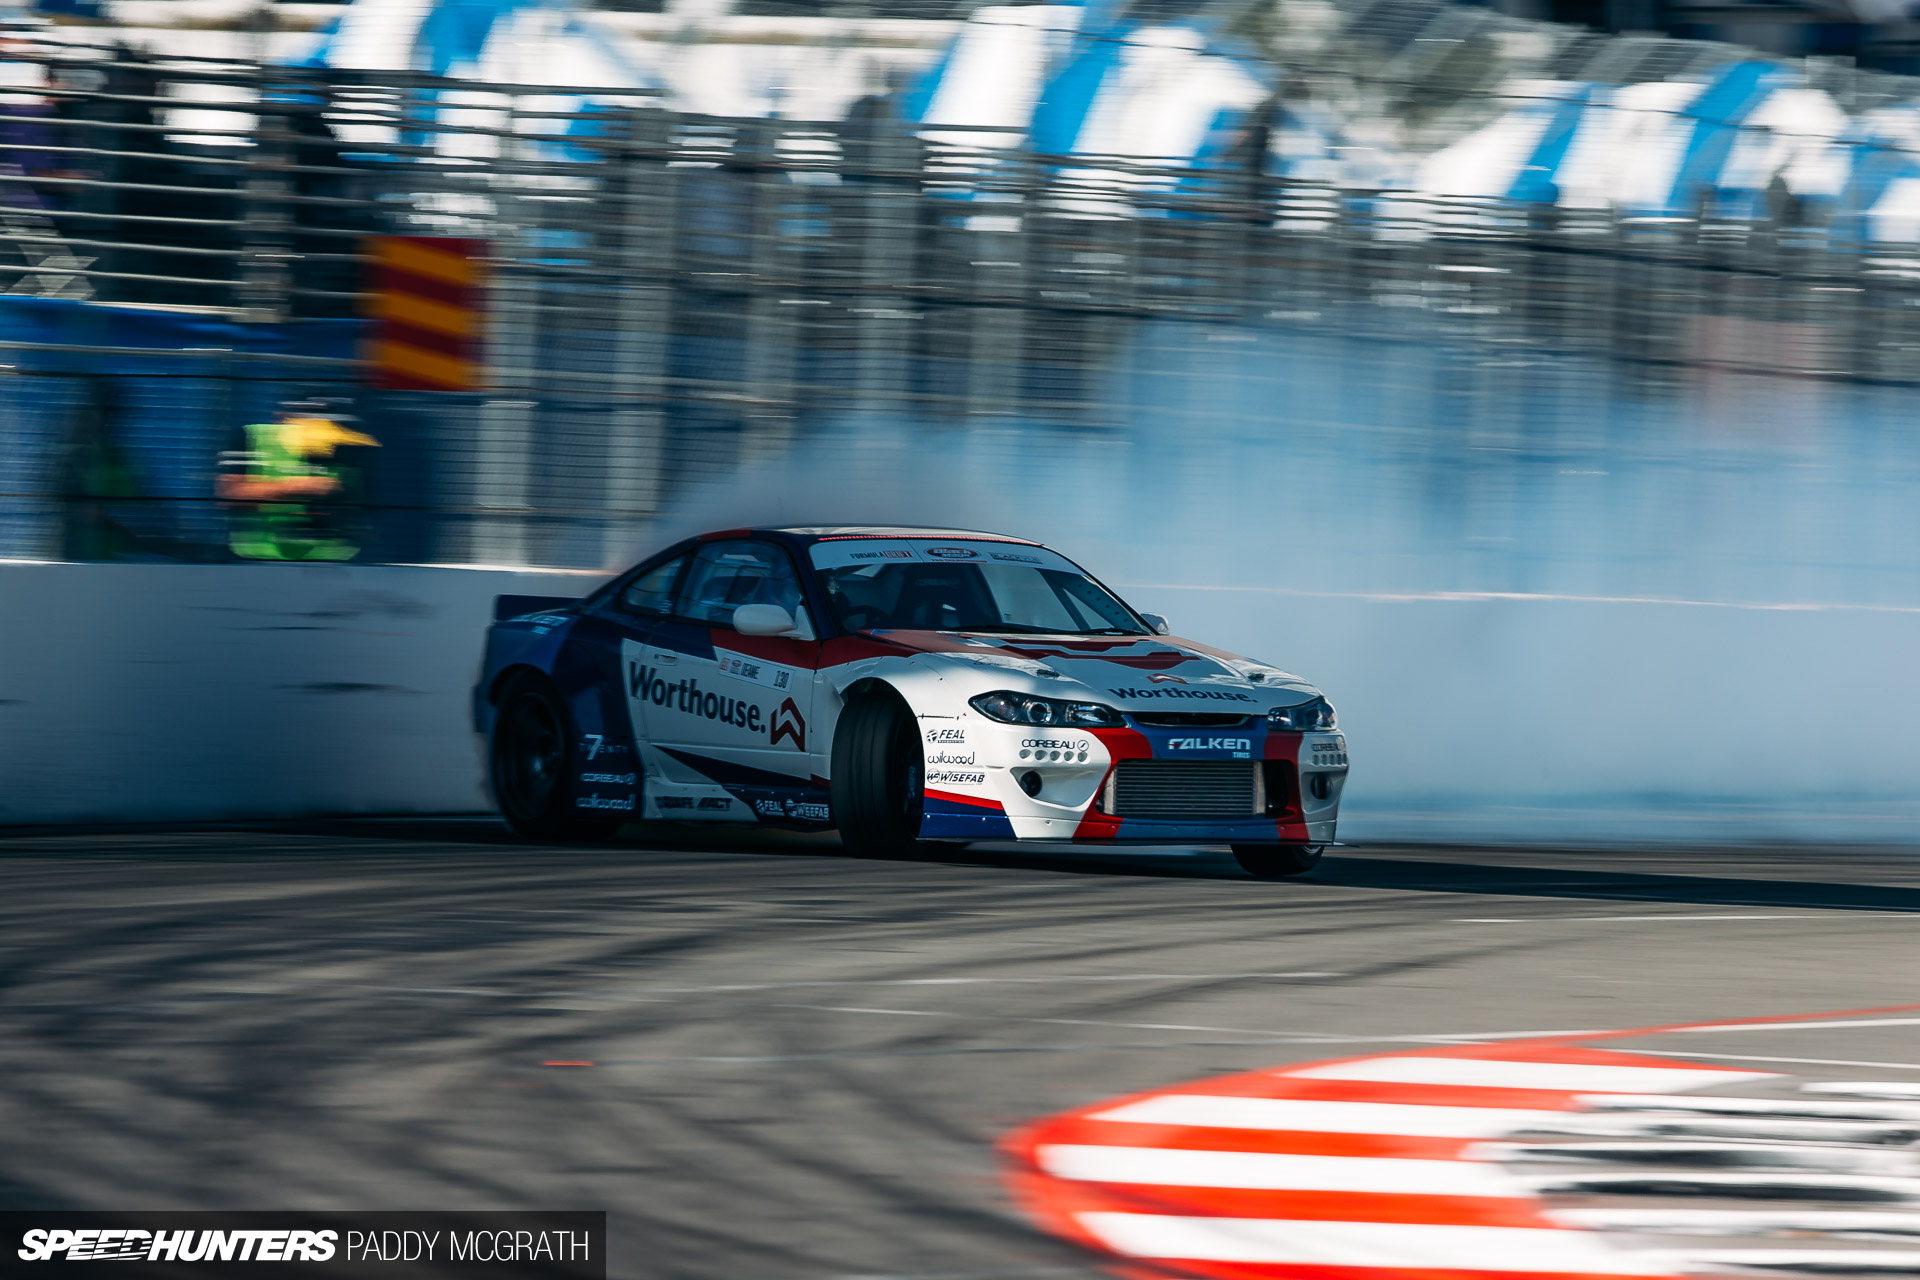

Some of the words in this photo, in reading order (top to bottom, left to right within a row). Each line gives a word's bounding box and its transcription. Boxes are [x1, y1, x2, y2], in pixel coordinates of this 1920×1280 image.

[850, 551, 885, 560] FORMULA
[774, 670, 789, 688] 130
[629, 661, 766, 734] Worthouse.
[1108, 687, 1258, 703] Worthouse.
[939, 729, 965, 739] FEAL
[1021, 739, 1076, 749] CORBEAU
[1168, 738, 1251, 750] FALKEN
[927, 750, 975, 765] wilwood
[940, 771, 985, 783] WISEFAB
[764, 800, 784, 811] FEAL
